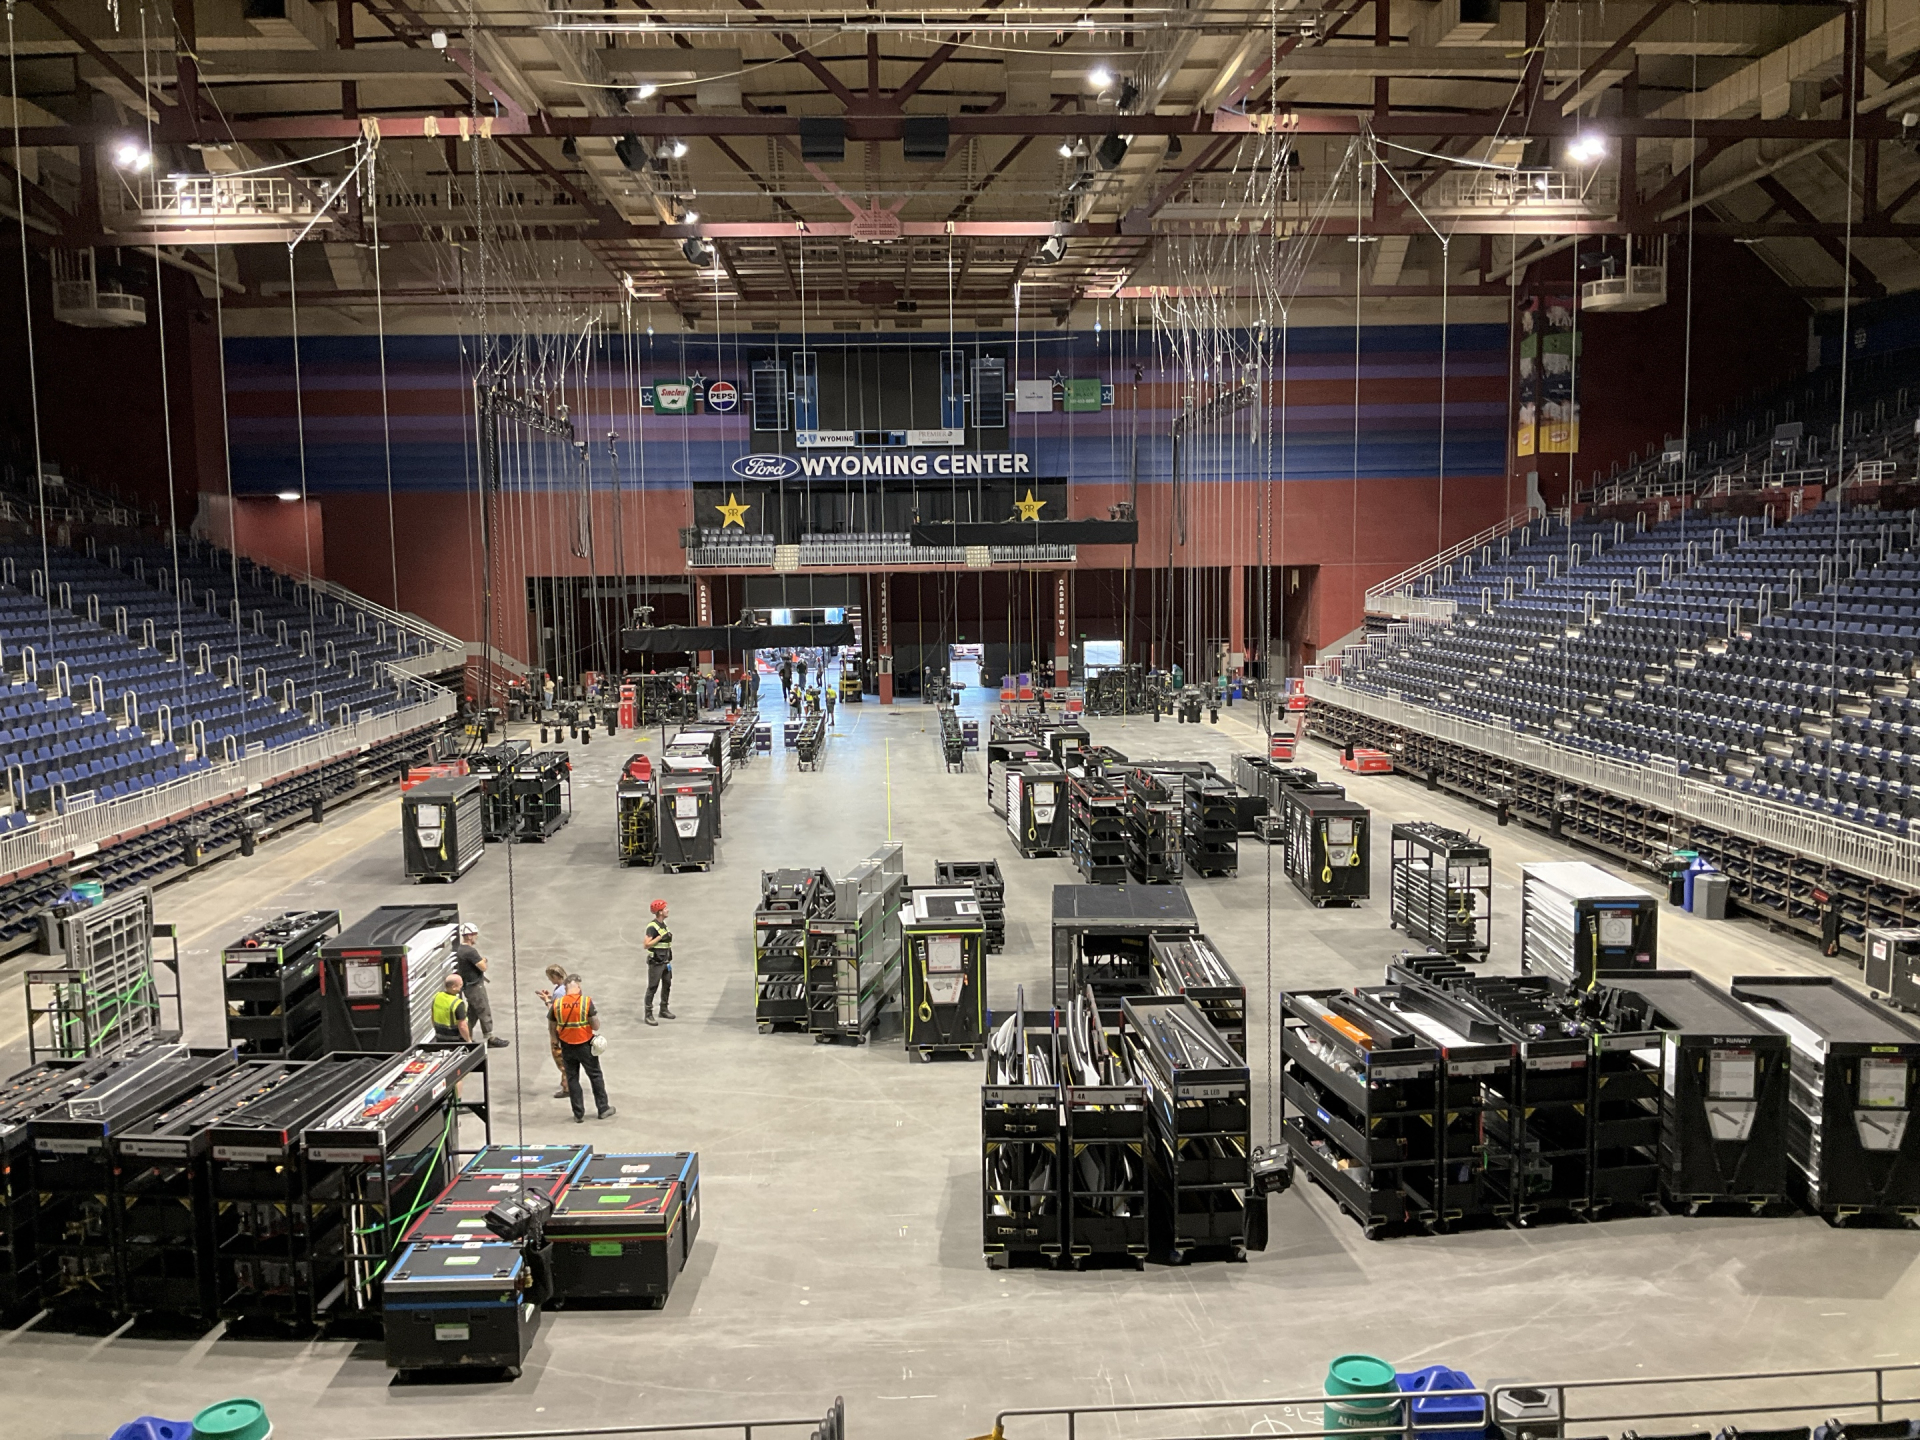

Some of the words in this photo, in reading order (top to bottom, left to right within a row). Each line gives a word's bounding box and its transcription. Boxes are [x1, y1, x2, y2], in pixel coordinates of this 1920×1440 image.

[660, 388, 686, 396] Sinclair
[744, 457, 787, 475] Ford
[800, 455, 928, 476] WYOMING
[933, 453, 1030, 475] CENTER
[1058, 619, 1066, 637] WYO
[991, 1091, 999, 1099] 4A
